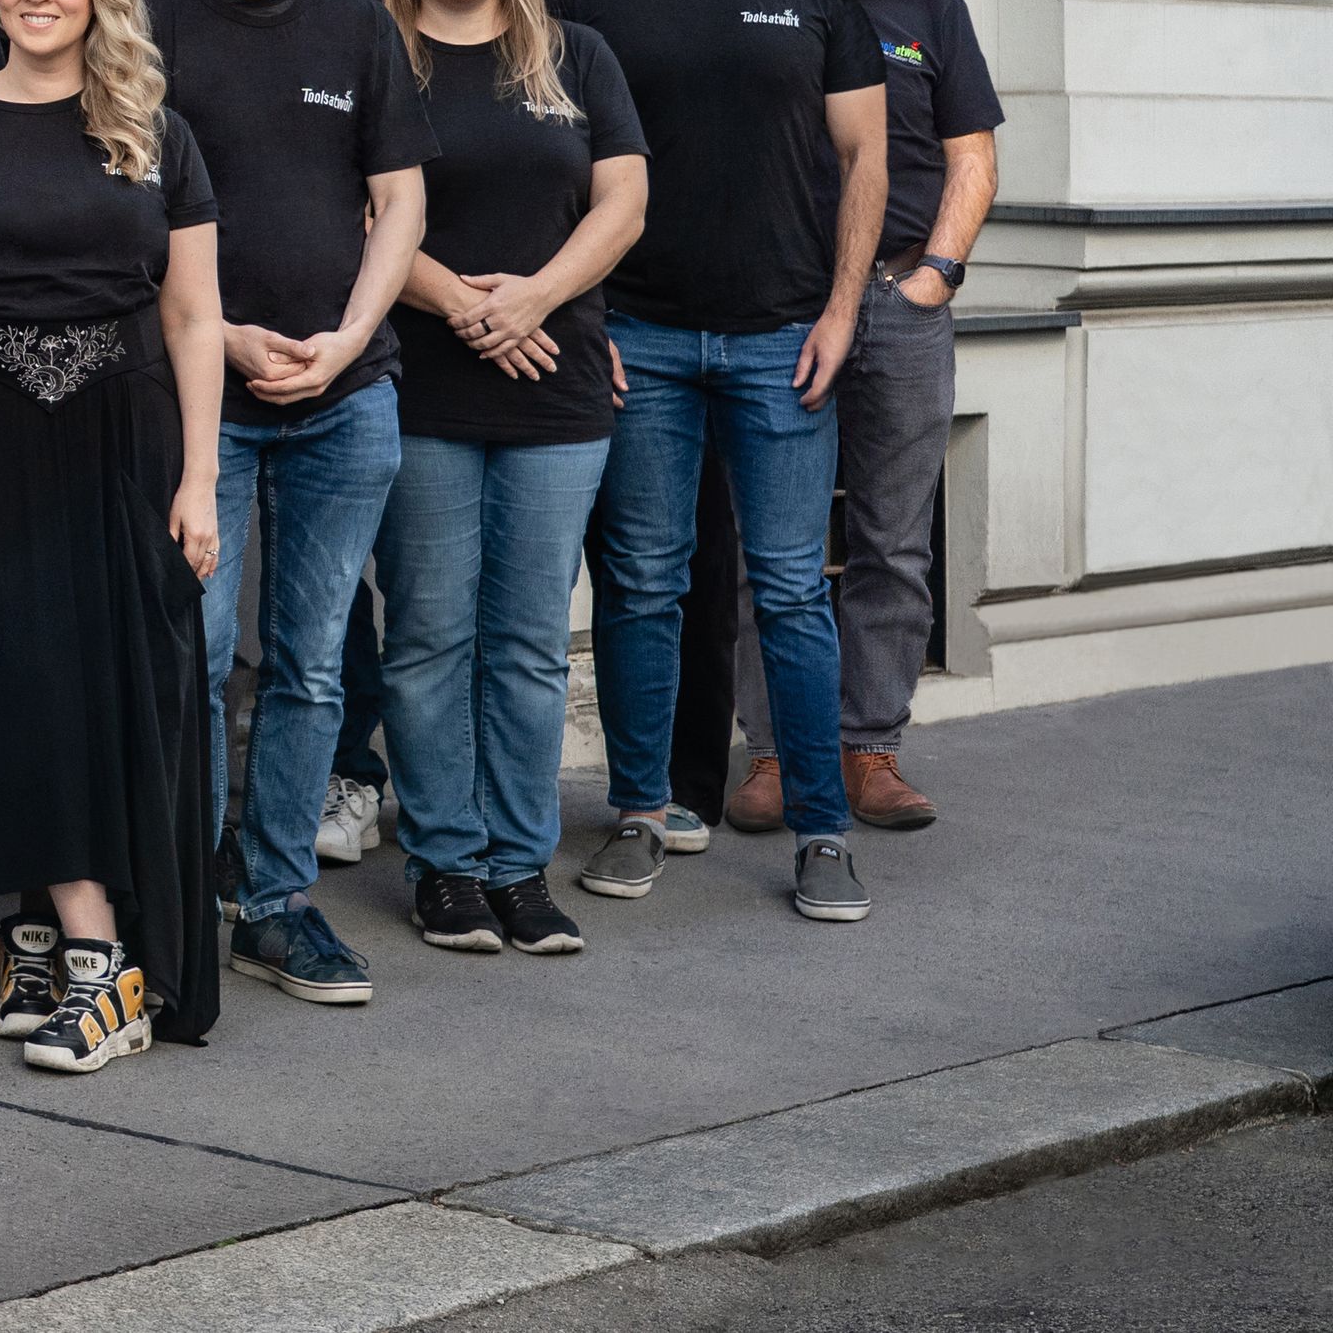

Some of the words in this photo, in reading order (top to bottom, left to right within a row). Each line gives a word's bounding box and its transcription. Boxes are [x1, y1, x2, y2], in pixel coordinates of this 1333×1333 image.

[740, 11, 800, 28] Toolsatwork
[21, 930, 51, 943] NIKE
[70, 956, 98, 969] NIKE
